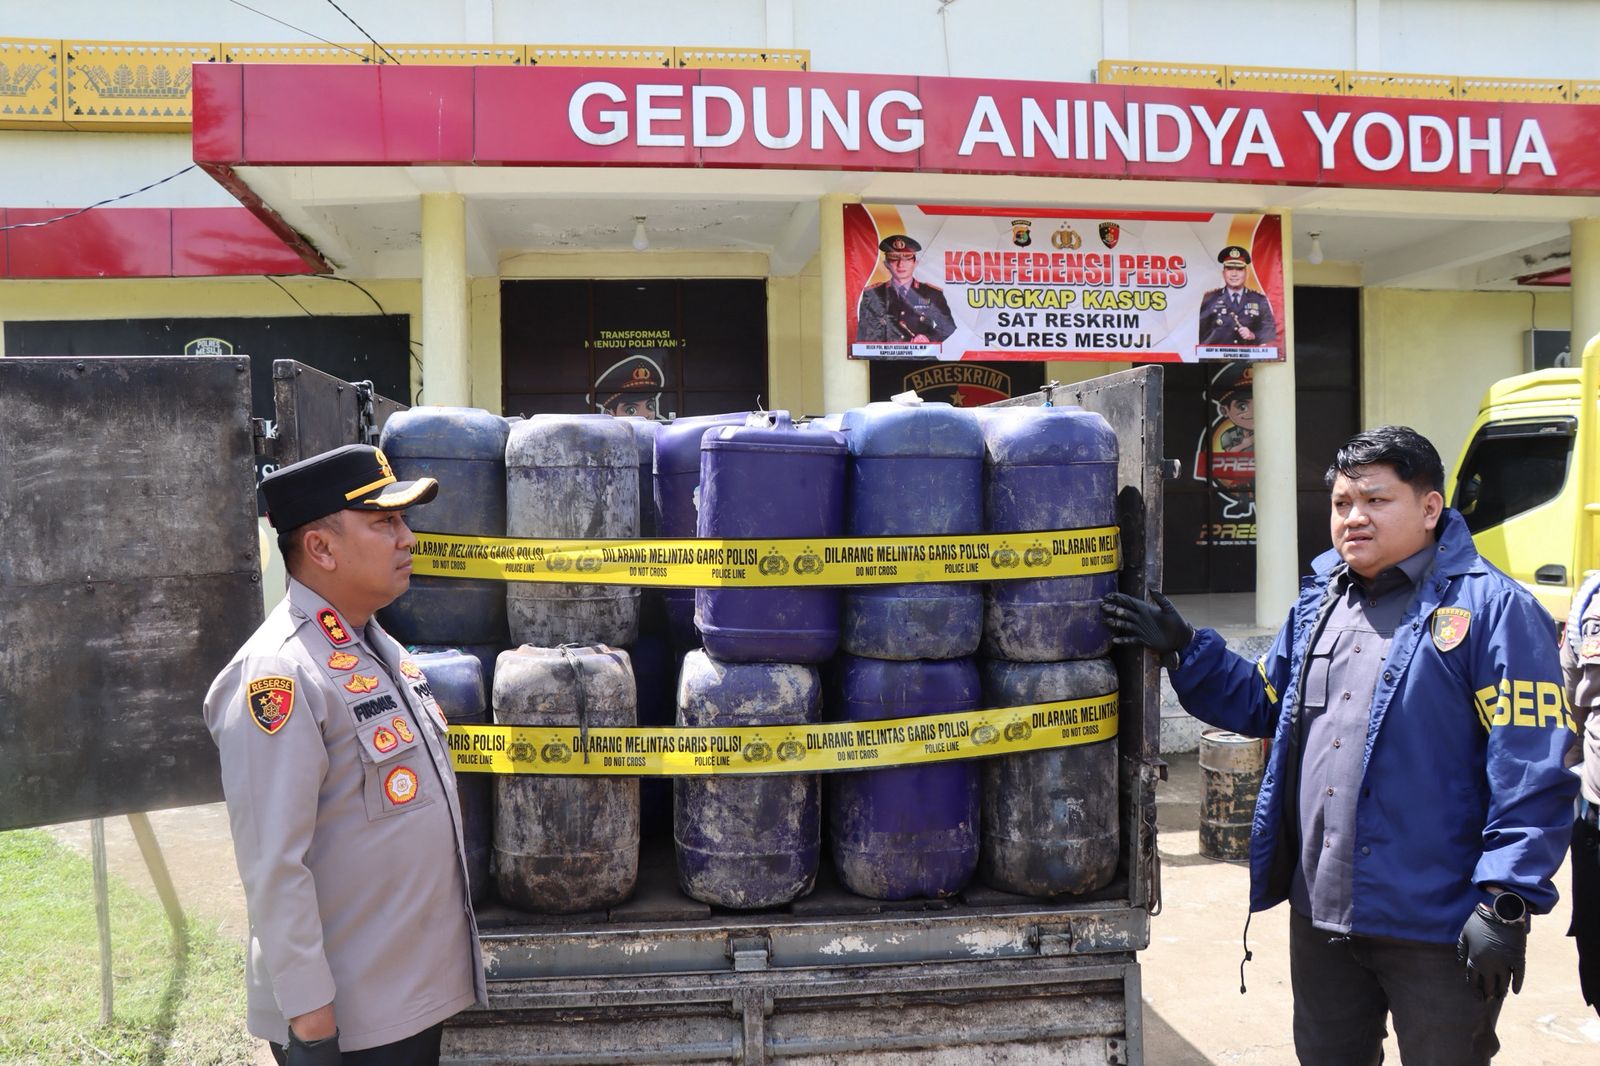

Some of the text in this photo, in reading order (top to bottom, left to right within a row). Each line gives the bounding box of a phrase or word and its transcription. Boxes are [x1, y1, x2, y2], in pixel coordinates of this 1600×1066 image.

[568, 81, 1557, 176] GEDUNG ANINDYA YODHA
[944, 250, 1187, 288] KONFERENSI PERS
[967, 288, 1167, 311] UNGKAP KASUS
[998, 312, 1139, 329] SAT RESKRIM
[600, 330, 670, 339] TRANSFORMASI
[984, 332, 1151, 348] POLRES MESUJI
[628, 340, 655, 348] POLRI
[911, 367, 1003, 390] BARESKRIM
[448, 543, 488, 559] MELINTAS
[490, 545, 515, 560] GARIS
[517, 546, 545, 560] POLISI
[825, 543, 990, 563] DILARANG MELINTAS GARIS POLISI
[1053, 537, 1096, 555] DILARANG
[602, 548, 757, 565] DILARANG MELINTAS GARIS POLISI
[1082, 555, 1114, 567] DO NOT CROSS
[433, 560, 466, 570] DO NOT CROSS
[505, 563, 535, 573] POLICE LINE
[630, 567, 667, 577] DO NOT CROSS
[856, 566, 897, 576] DO NOT CROSS
[945, 563, 978, 573] POLICE LINE
[712, 568, 746, 579] POLICE LINE
[252, 679, 291, 691] RESERSE
[353, 695, 397, 722] FIRDAUS
[1032, 701, 1116, 728] DILARANG MELINTAS
[806, 720, 969, 750] DILARANG MELINTAS GARIS POLISI
[1062, 724, 1099, 738] DO NOT CROSS
[446, 734, 505, 751] ARIS POLISI
[625, 736, 675, 753] MELINTAS
[678, 736, 707, 753] GARIS
[711, 735, 742, 752] POLISI
[925, 741, 959, 753] POLICE LINE
[457, 754, 493, 764] POLICE LINE
[604, 757, 646, 767] DO NOT CROSS
[695, 756, 730, 766] POLICE LINE
[837, 749, 878, 761] DO NOT CROSS
